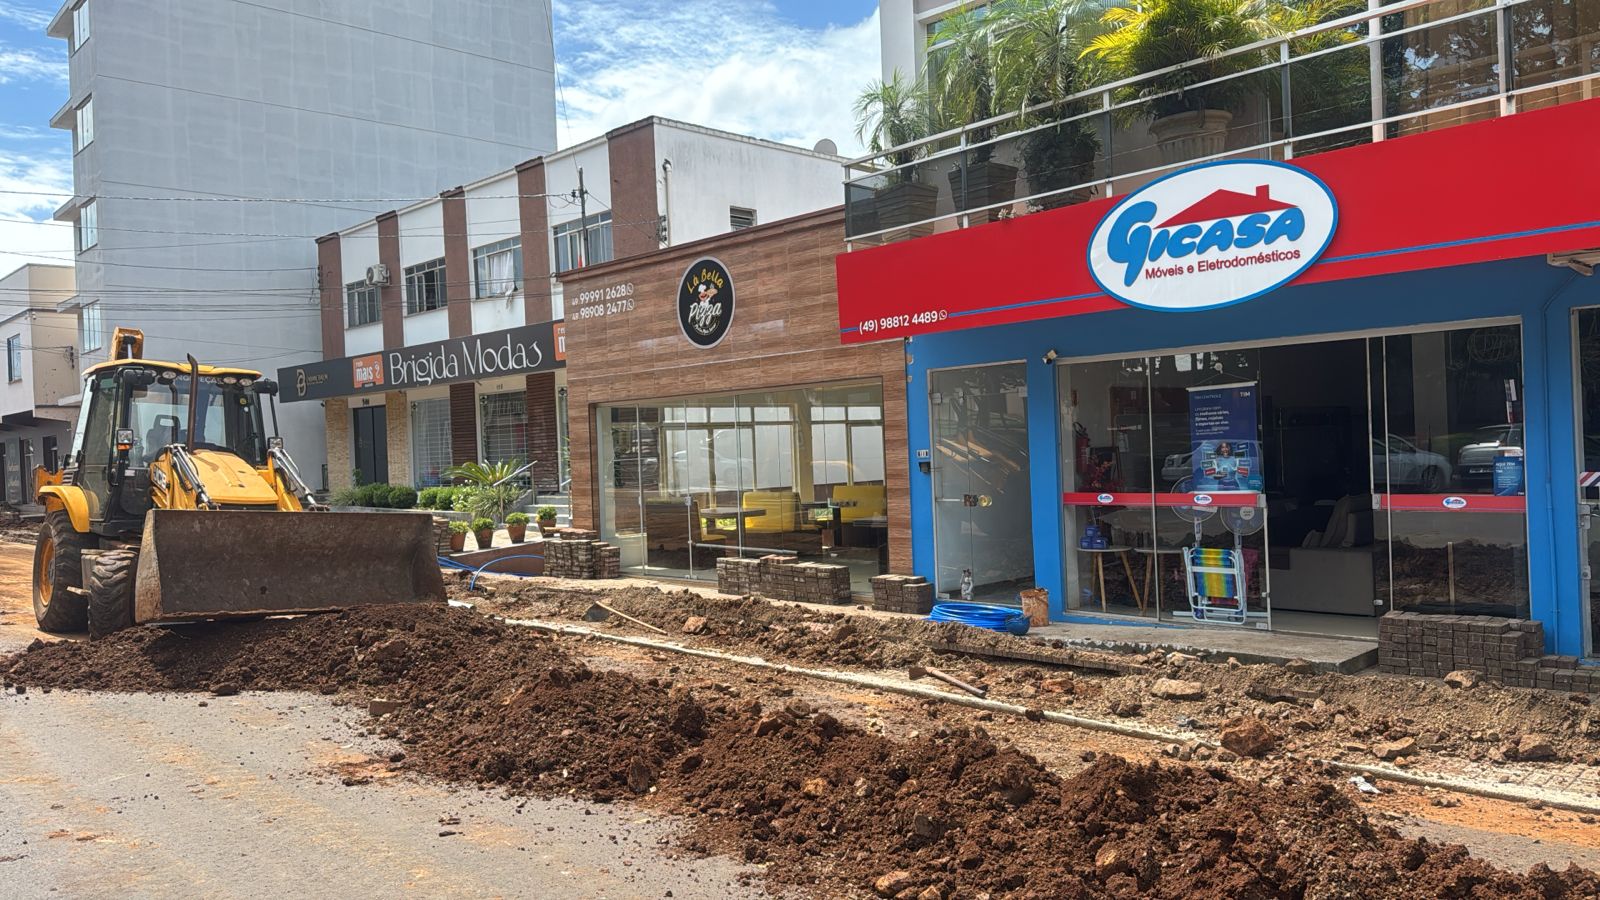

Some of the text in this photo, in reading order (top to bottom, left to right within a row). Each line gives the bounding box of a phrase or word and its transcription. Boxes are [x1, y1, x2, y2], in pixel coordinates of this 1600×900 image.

[1145, 249, 1301, 280] Móveis e Eletrodomésticos
[686, 268, 725, 294] La Bella
[579, 289, 604, 304] 99991
[605, 284, 627, 300] 2628
[580, 304, 605, 319] 98908
[606, 300, 627, 315] 2477
[688, 302, 722, 326] Pizza
[859, 311, 938, 335] (49) 98812 4489
[389, 345, 458, 386] Brigida
[462, 333, 543, 375] Modas
[356, 366, 374, 382] mais
